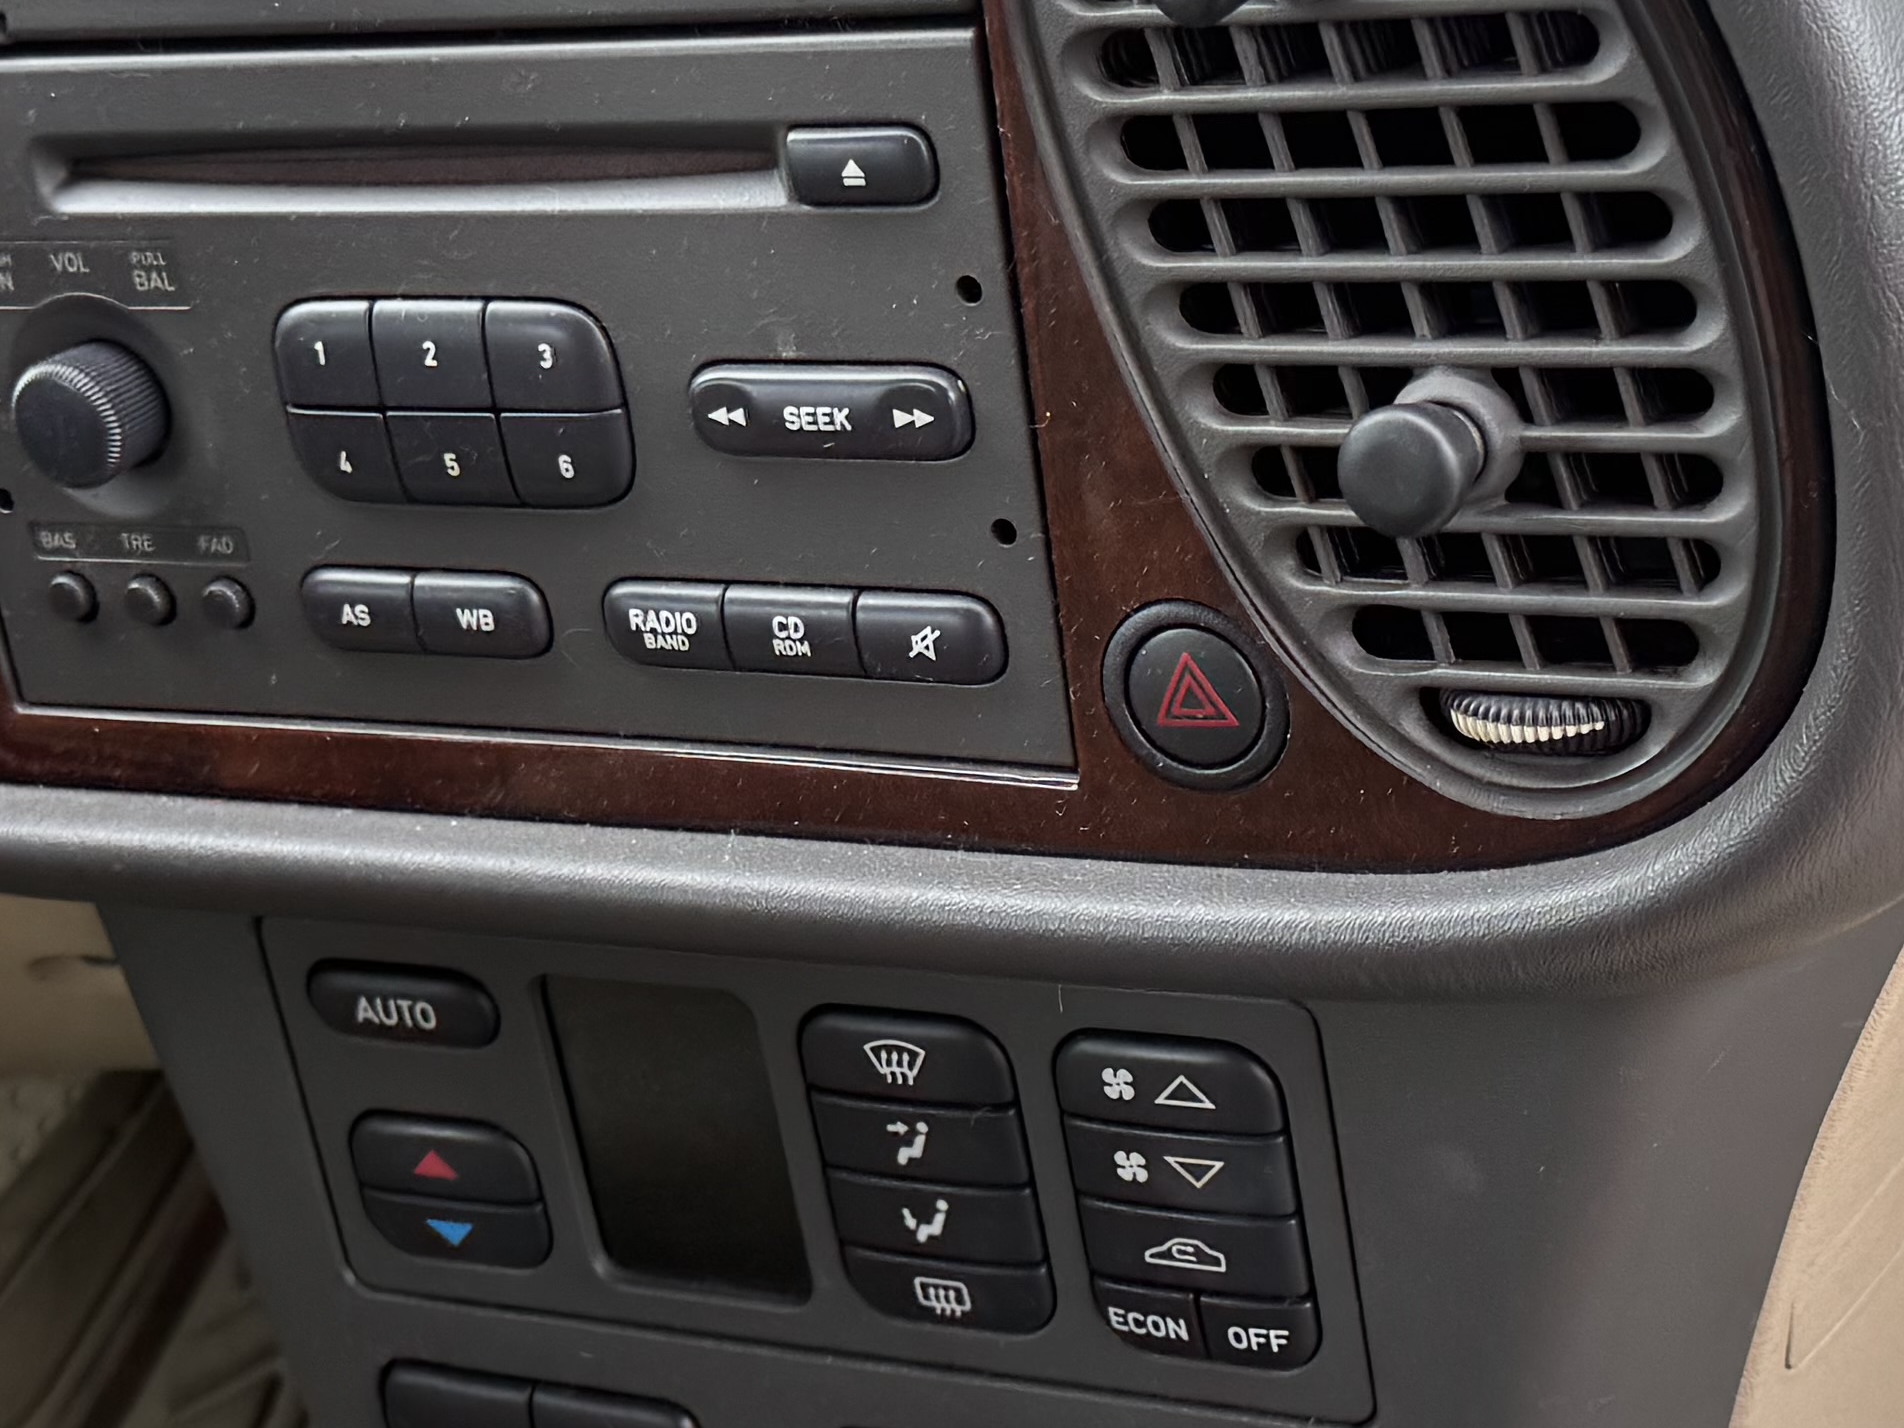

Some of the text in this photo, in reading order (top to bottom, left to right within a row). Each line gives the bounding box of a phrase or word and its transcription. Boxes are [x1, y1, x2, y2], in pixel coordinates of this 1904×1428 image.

[50, 252, 90, 273] VOL
[132, 270, 176, 292] BAL
[314, 340, 326, 367] 1
[422, 340, 438, 367] 2
[537, 342, 554, 369] 3
[783, 405, 853, 432] SEEK
[338, 450, 353, 473] 4
[443, 452, 461, 477] 5
[558, 454, 576, 479] 6
[40, 530, 77, 551] BAS
[120, 532, 156, 553] TRE
[198, 533, 234, 554] FAD
[341, 603, 371, 627] AS
[456, 607, 496, 632] WB
[629, 608, 698, 635] RADIO
[772, 615, 806, 639] CD
[644, 632, 690, 652] BAND
[772, 638, 812, 658] RDM
[356, 995, 437, 1031] AUTO
[1107, 1307, 1190, 1342] ECON
[1227, 1325, 1291, 1353] OFF
